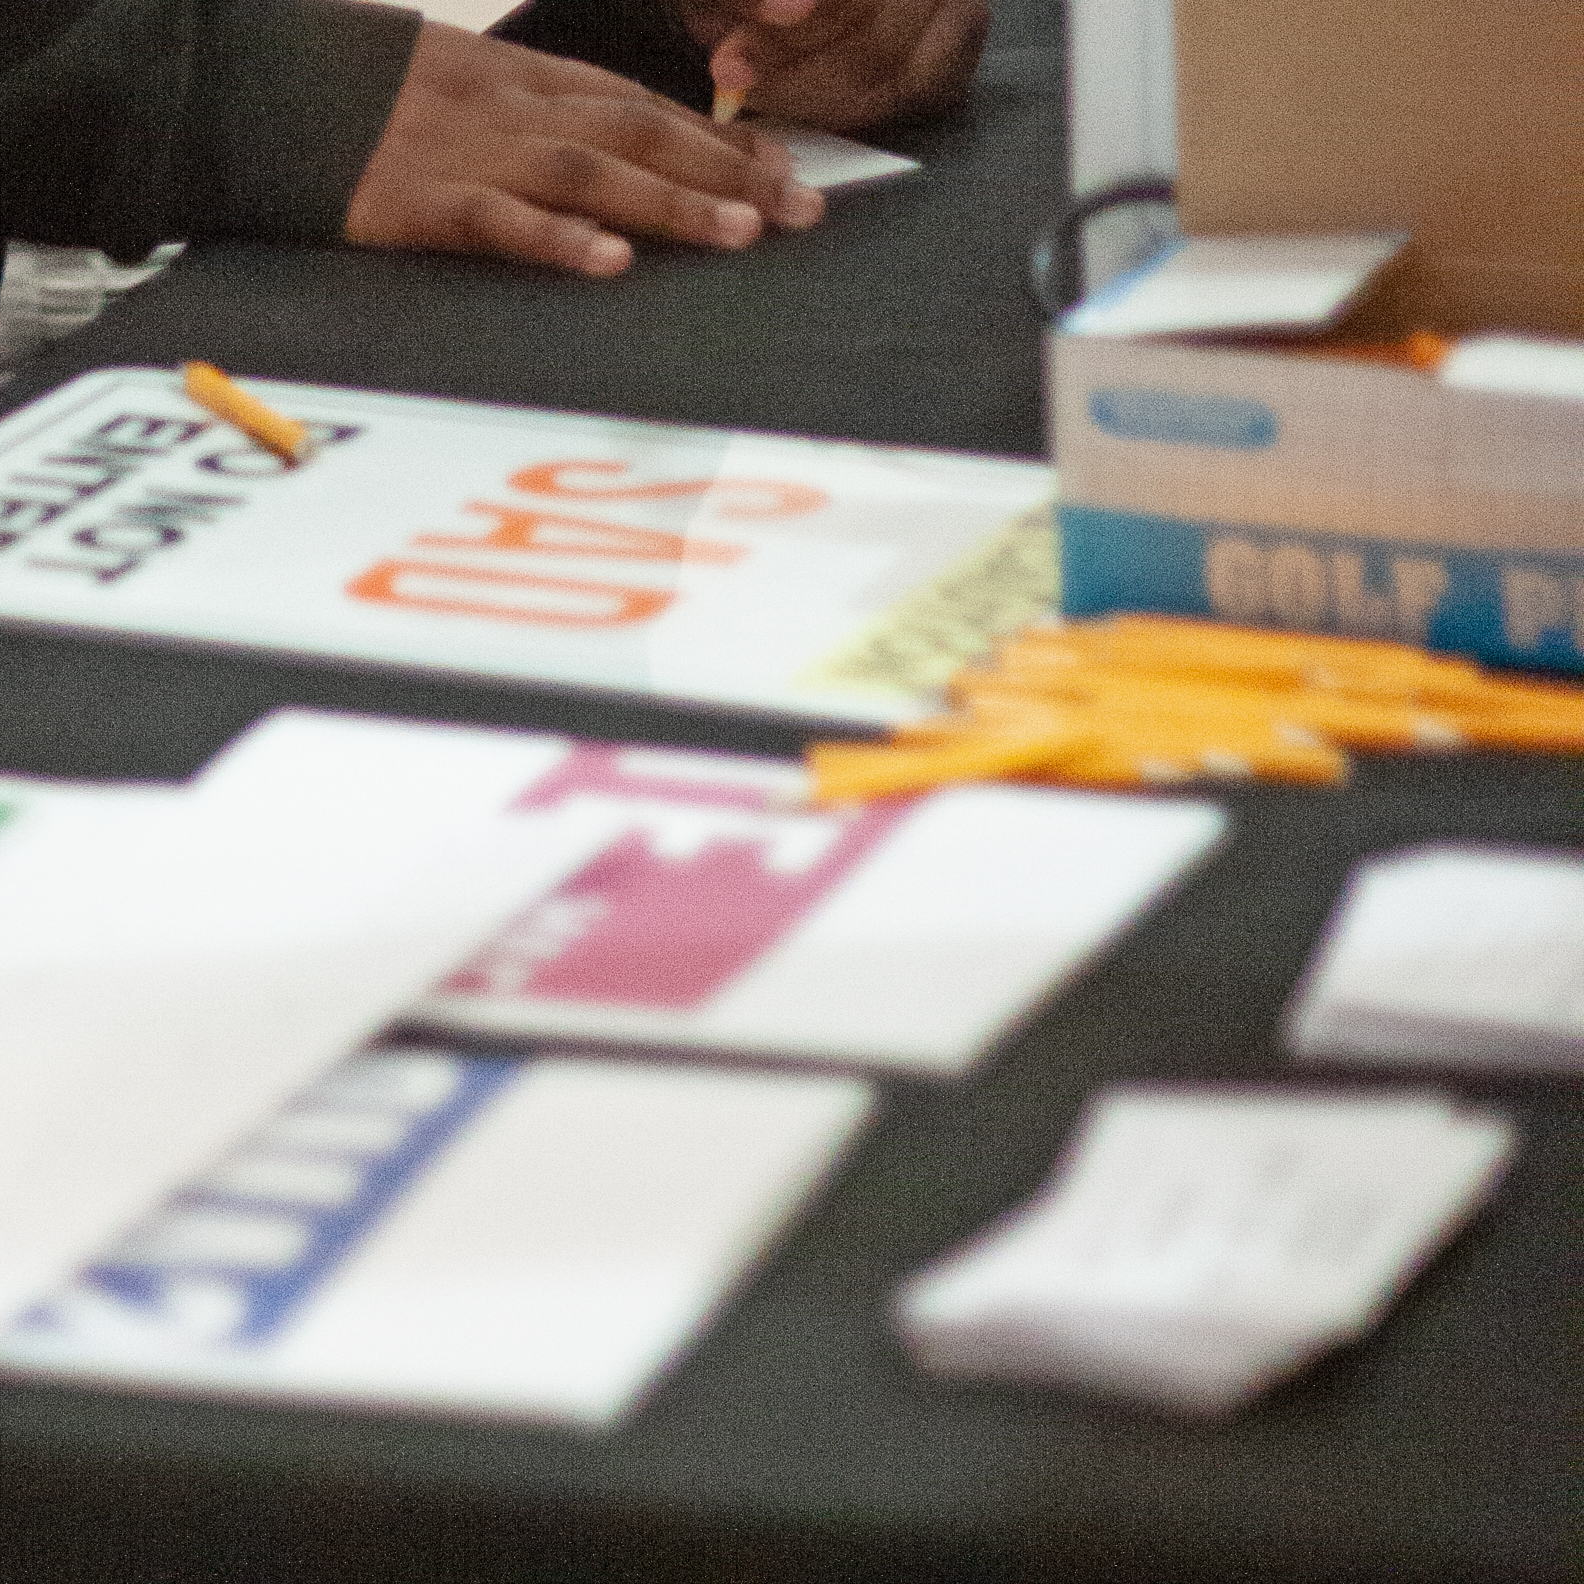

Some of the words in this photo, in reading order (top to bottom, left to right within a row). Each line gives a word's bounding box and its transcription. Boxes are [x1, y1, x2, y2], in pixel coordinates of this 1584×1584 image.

[24, 482, 247, 586] NOT
[342, 456, 832, 631] SAD
[1204, 534, 1450, 640] GOLF
[1502, 565, 1584, 654] P
